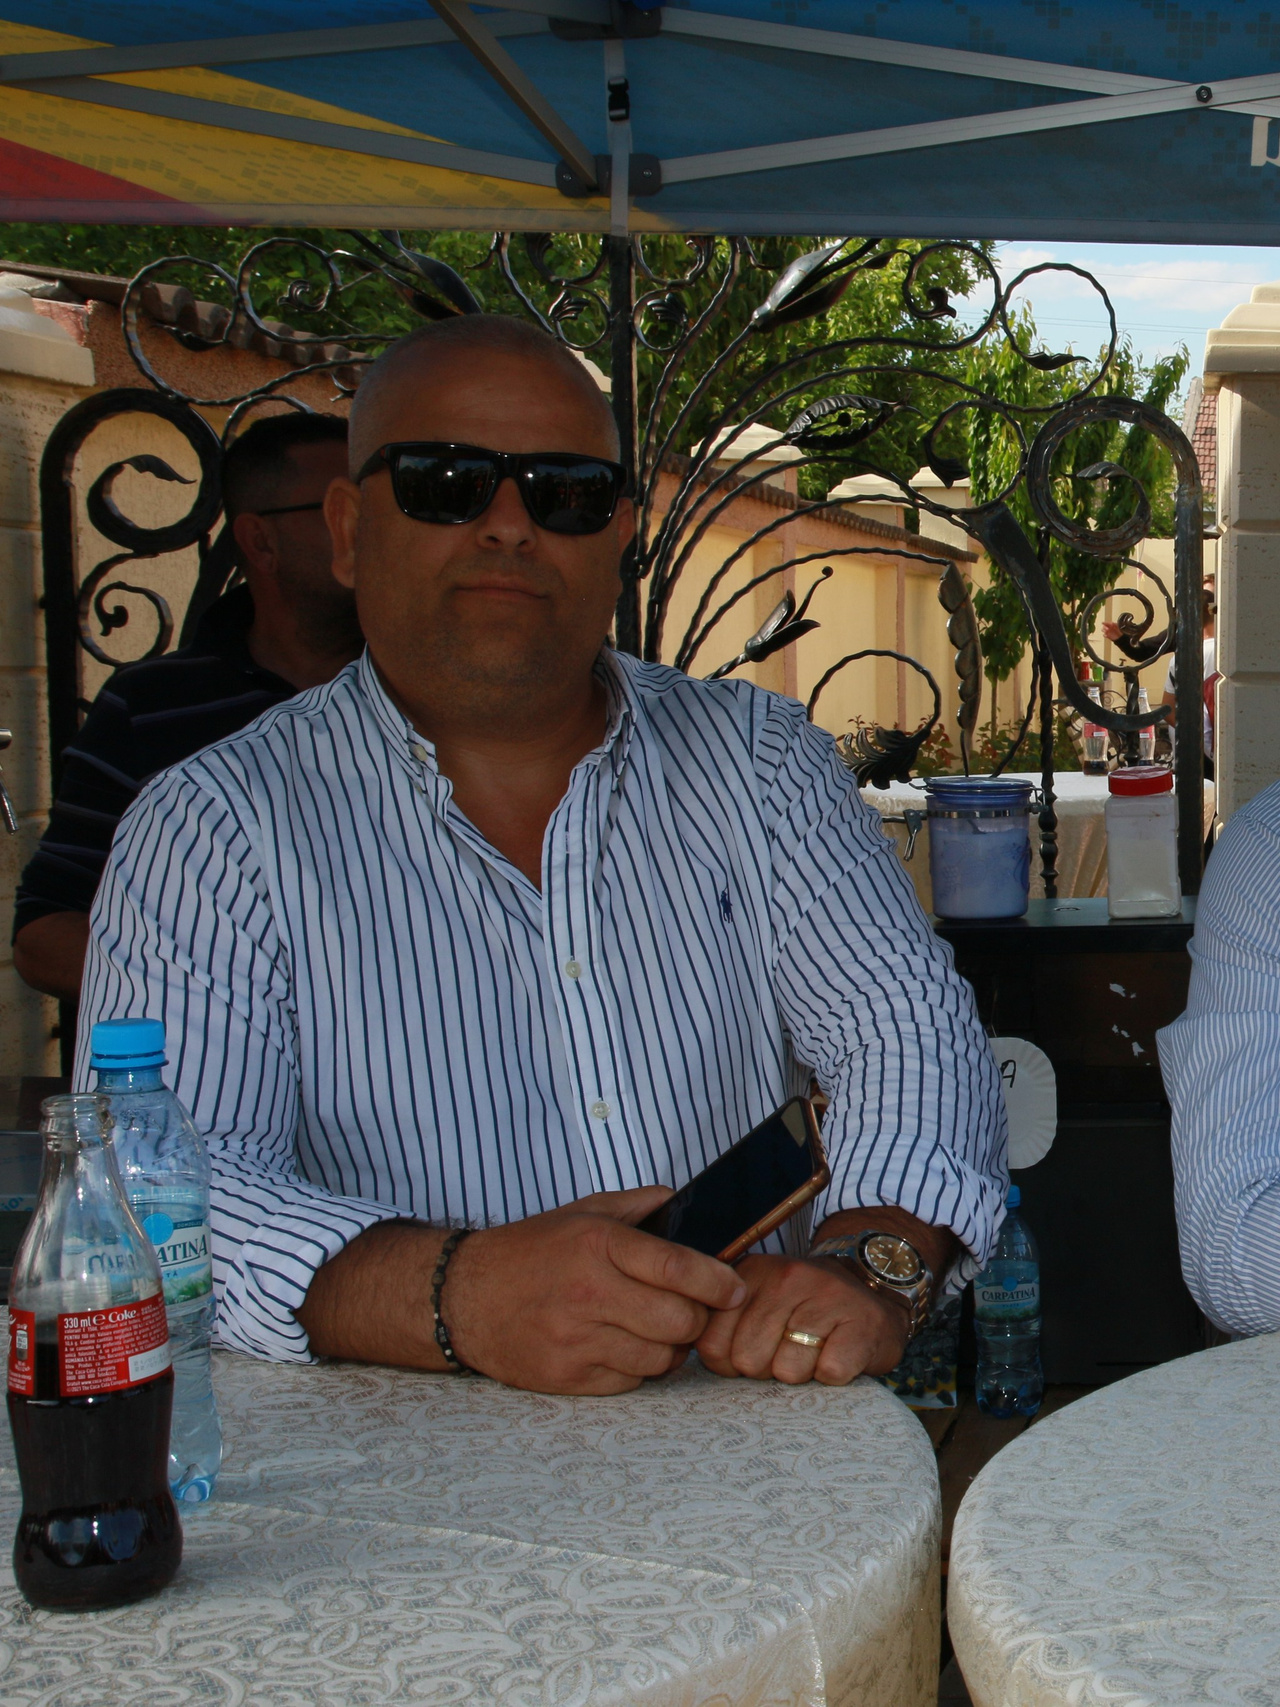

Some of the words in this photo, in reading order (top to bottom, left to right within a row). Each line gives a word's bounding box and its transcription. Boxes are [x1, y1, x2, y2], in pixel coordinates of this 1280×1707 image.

[981, 1287, 1036, 1302] CARPATINA
[63, 1317, 79, 1329] 330
[80, 1316, 91, 1328] ml
[108, 1309, 137, 1323] Coke
